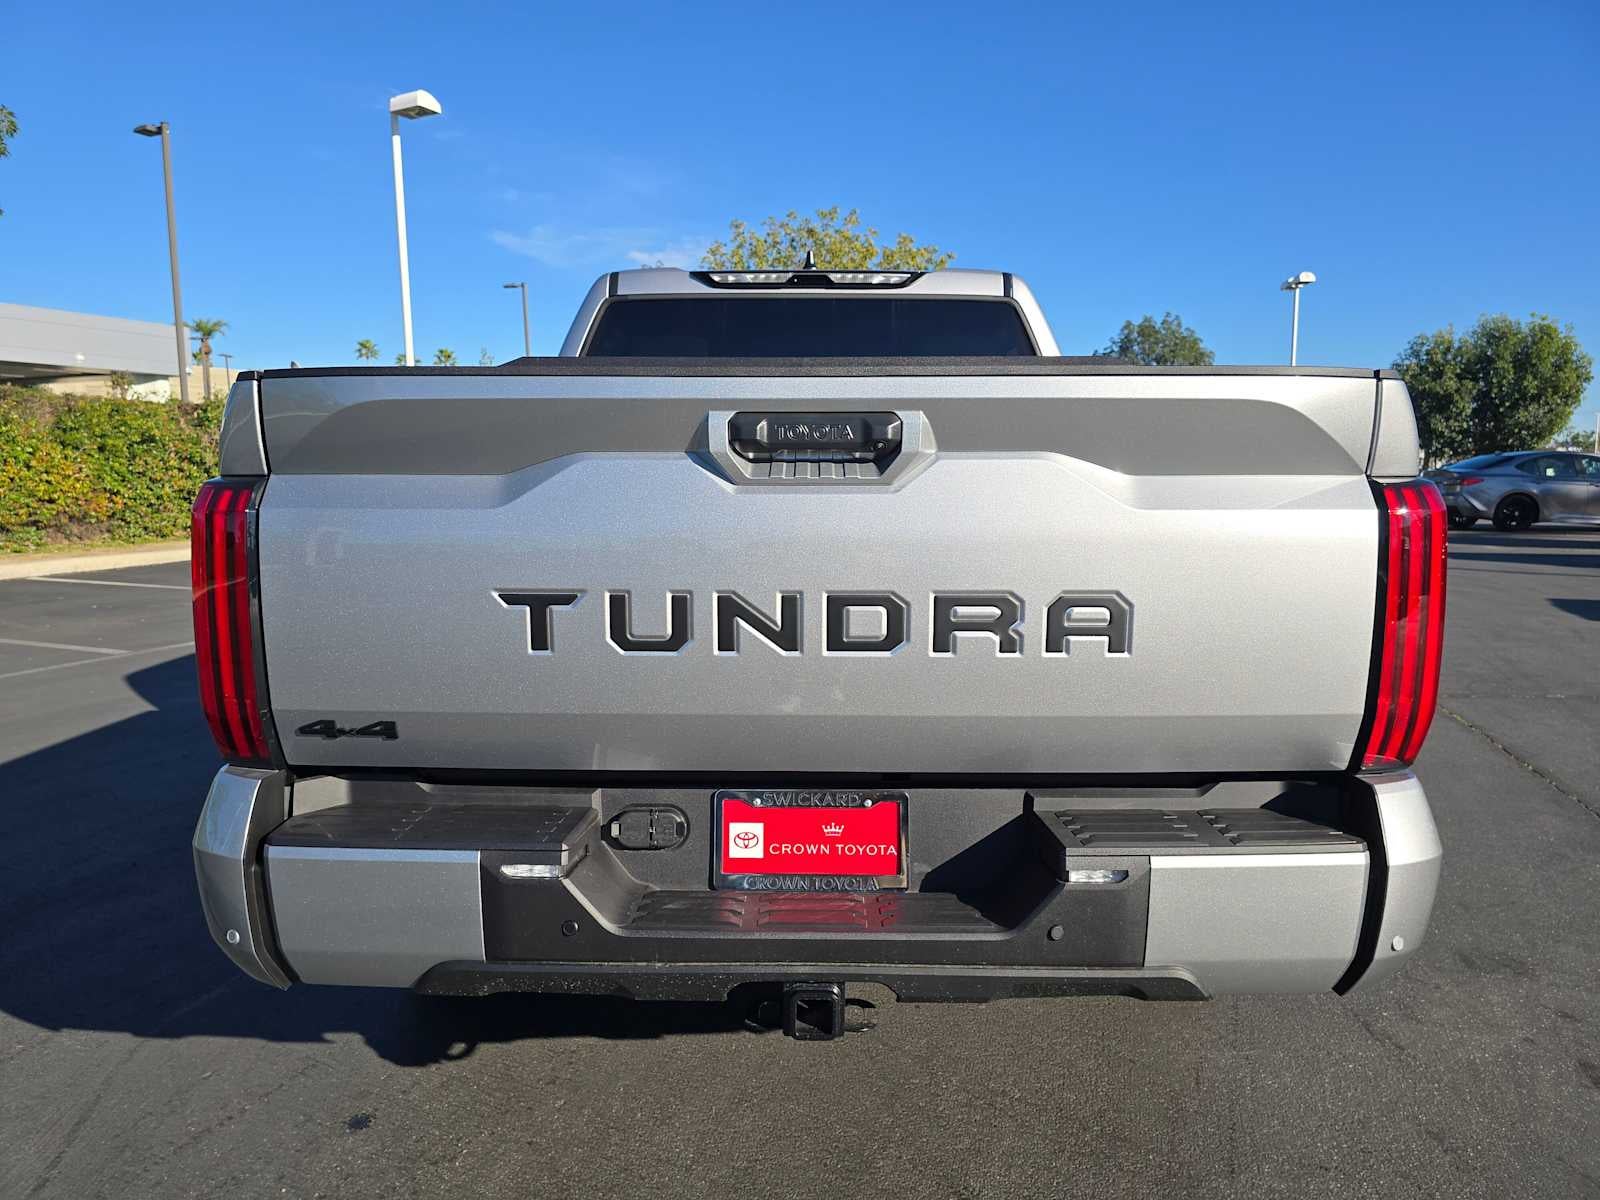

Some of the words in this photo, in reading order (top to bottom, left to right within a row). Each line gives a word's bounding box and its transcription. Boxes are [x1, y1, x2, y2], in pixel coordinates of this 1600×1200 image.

[775, 424, 854, 440] TOYOTA
[493, 588, 1134, 657] TUNDRA
[763, 792, 861, 807] SWICKARD
[769, 843, 830, 855] CROWN
[835, 844, 898, 856] TOYOTA
[744, 876, 809, 890] CROWN
[815, 876, 880, 891] TOYOTA
